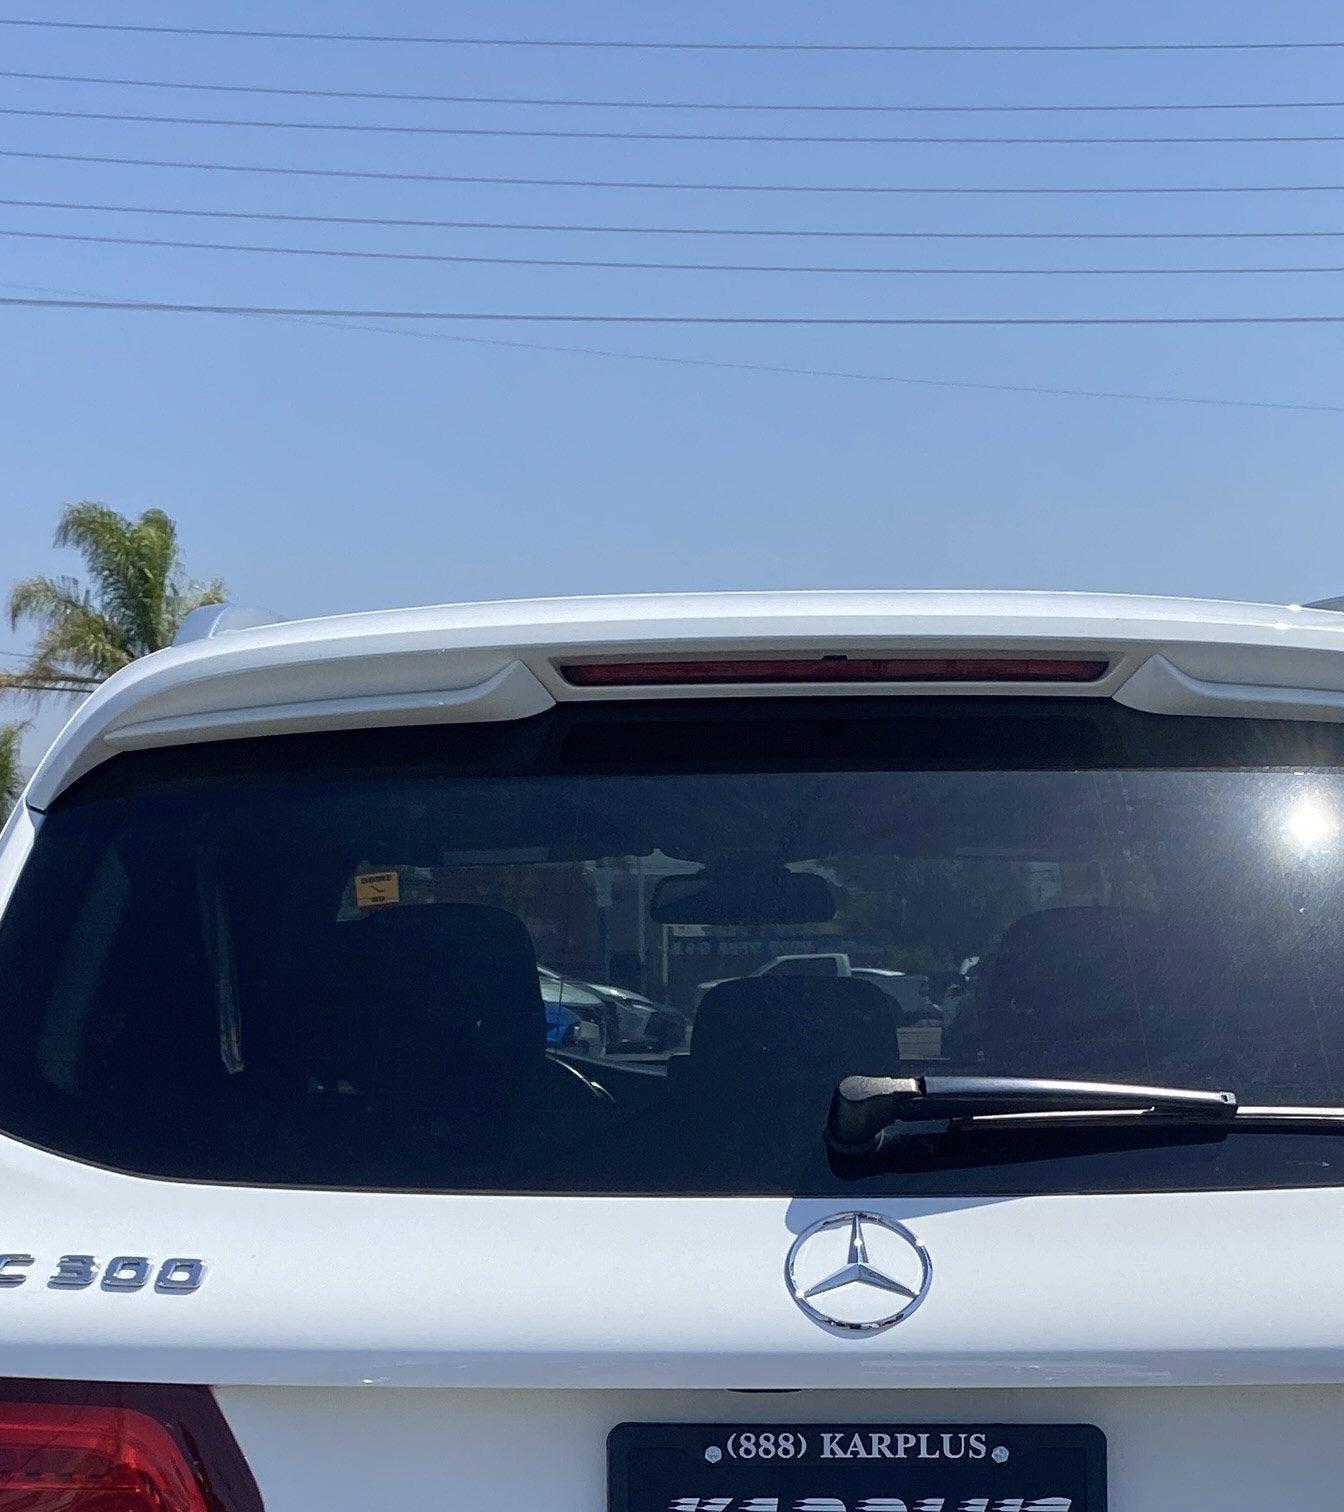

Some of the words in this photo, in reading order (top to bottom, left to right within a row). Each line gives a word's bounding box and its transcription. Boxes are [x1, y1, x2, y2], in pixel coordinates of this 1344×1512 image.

[47, 1253, 208, 1295] 300
[726, 1432, 807, 1460] (888)
[820, 1432, 987, 1459] KARPLUS
